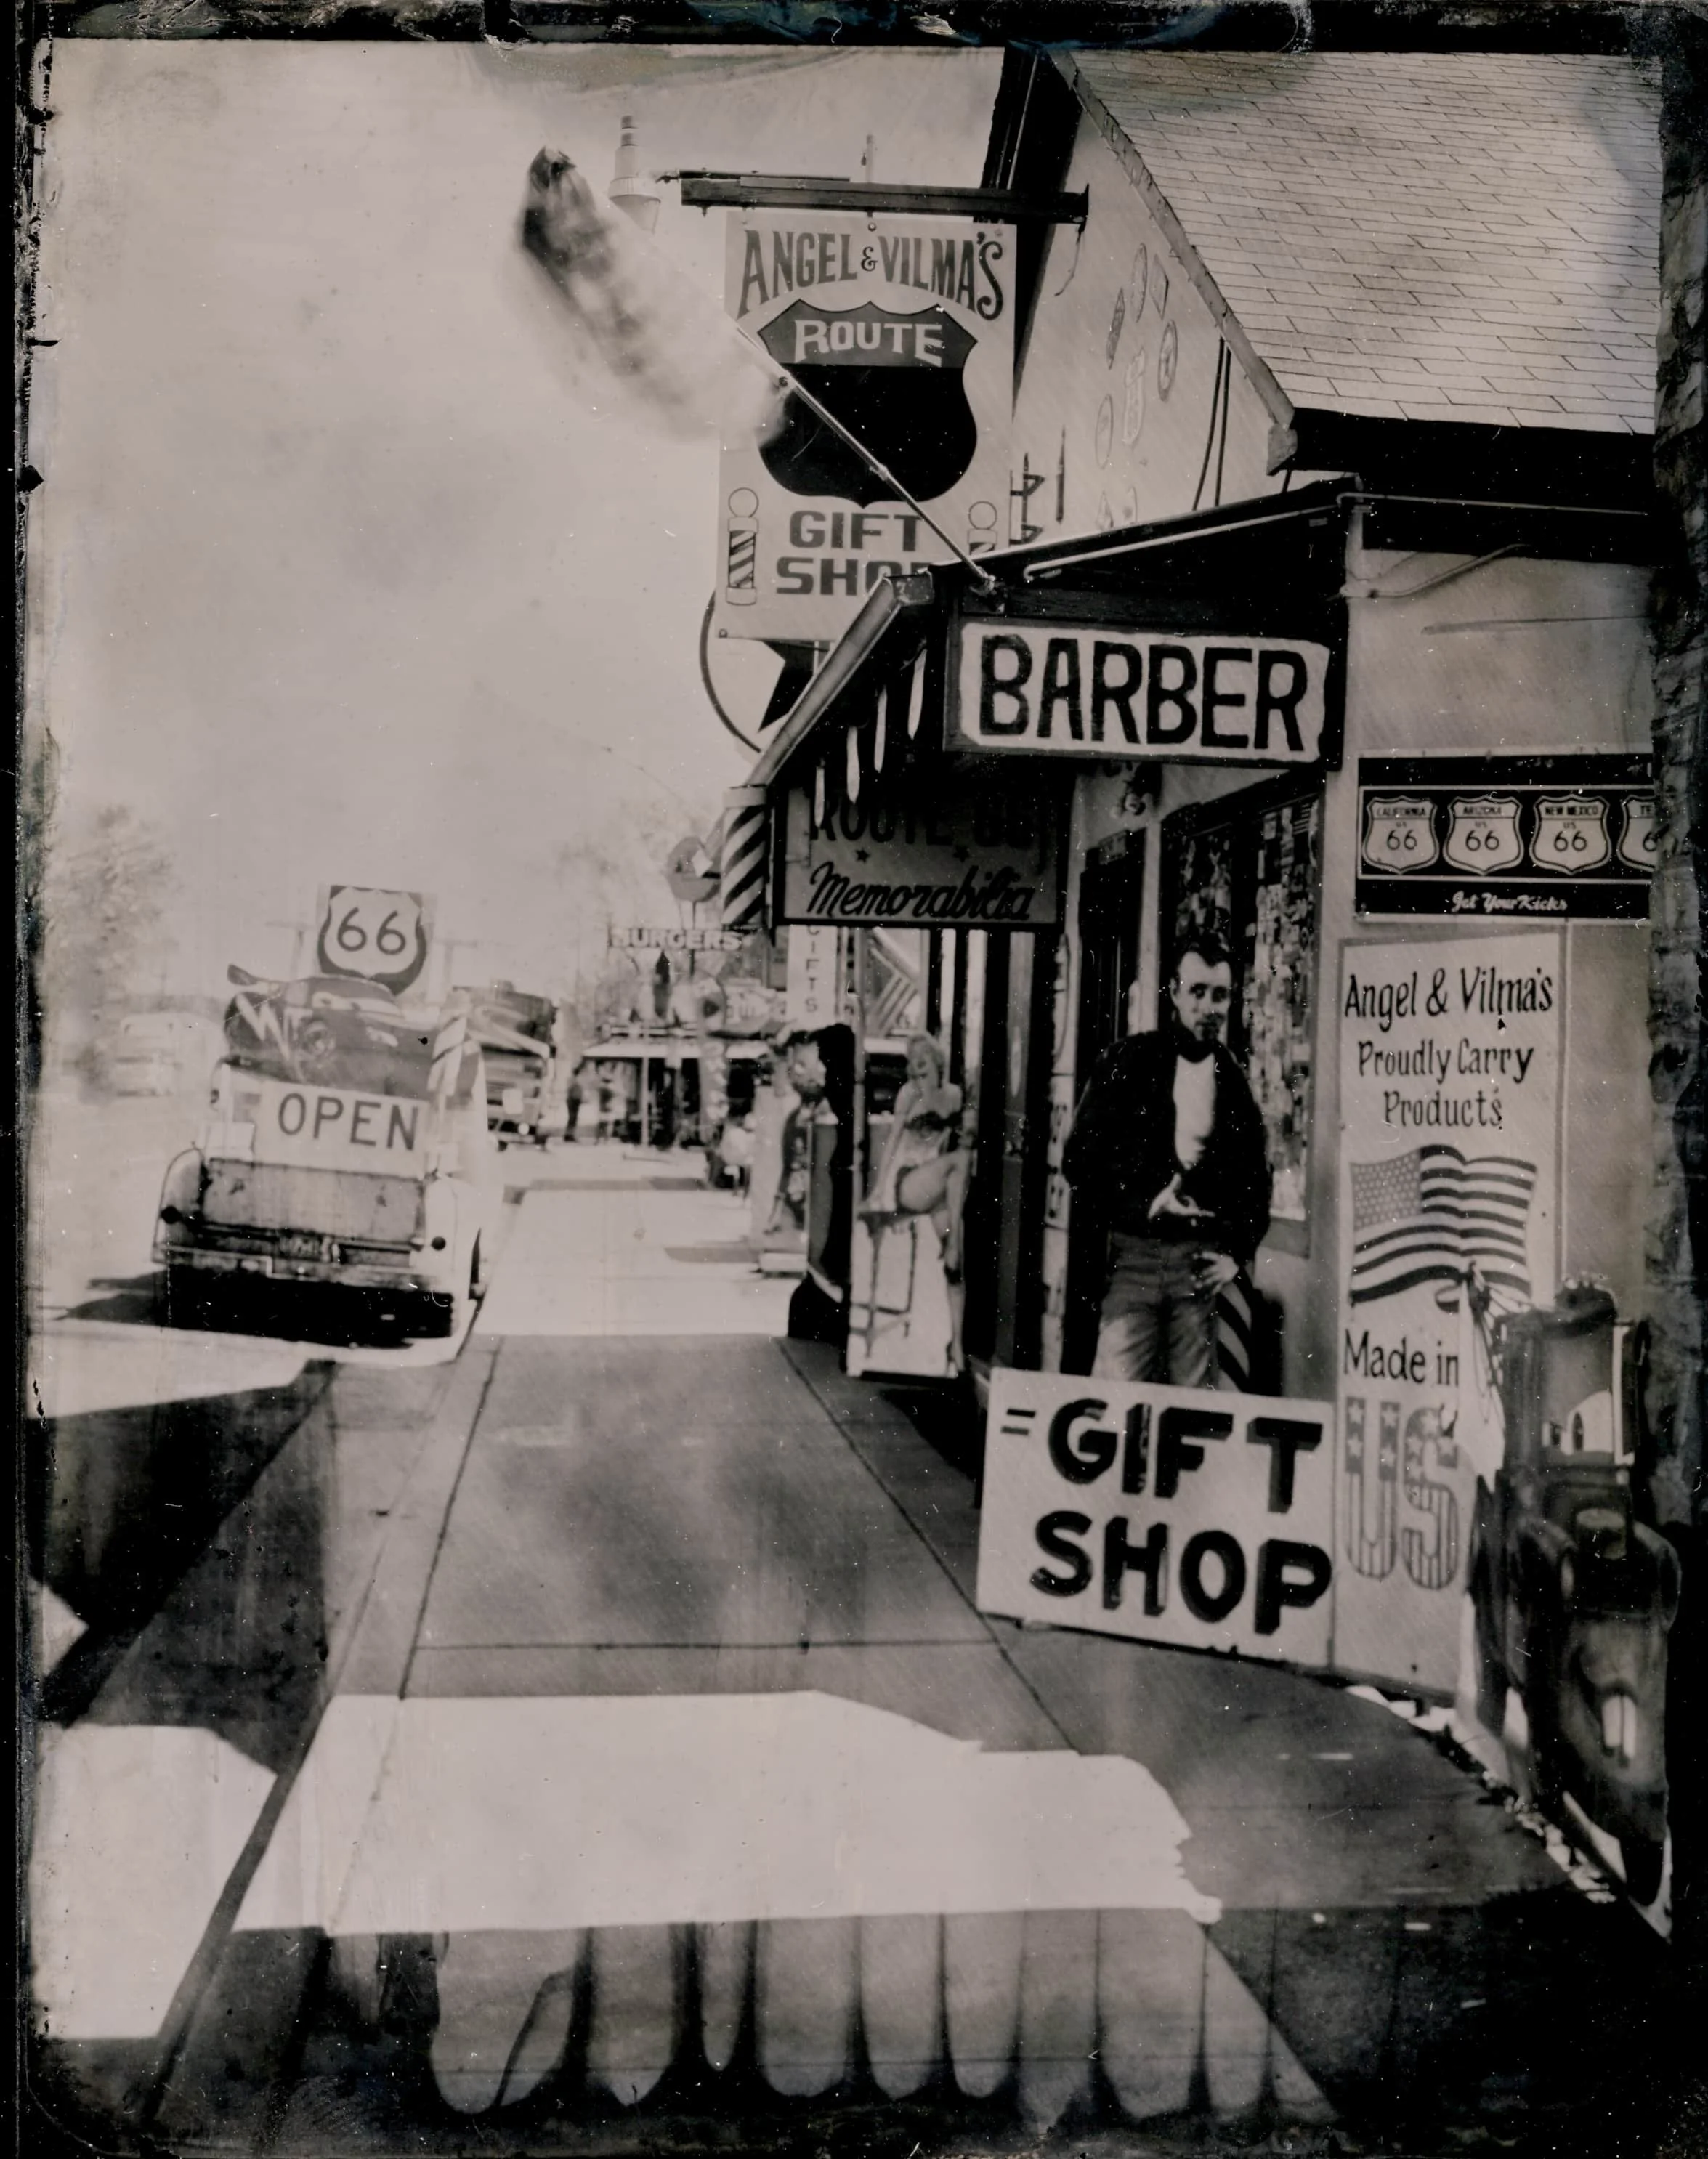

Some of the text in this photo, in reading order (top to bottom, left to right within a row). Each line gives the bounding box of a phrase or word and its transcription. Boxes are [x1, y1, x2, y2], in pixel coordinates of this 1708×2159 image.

[736, 229, 1004, 321] ANGEL & VILMA'S
[794, 318, 942, 368] ROUTE
[789, 510, 923, 552] GIFT
[979, 633, 1308, 753] BARBER
[1545, 806, 1599, 817] NEW MEXICO
[1386, 830, 1417, 851] 66
[1465, 830, 1499, 851] 66
[1553, 830, 1587, 852] 66
[806, 862, 1035, 921] Memorabilia
[336, 907, 407, 956] 66
[1344, 965, 1553, 1032] Angel & Vilma's
[1358, 1038, 1535, 1085] Proudly Carry
[278, 1092, 419, 1151] OPEN
[1383, 1089, 1503, 1128] Products
[1344, 1329, 1460, 1387] Made in
[1048, 1396, 1324, 1513] GIFT
[1030, 1510, 1332, 1635] SHOP
